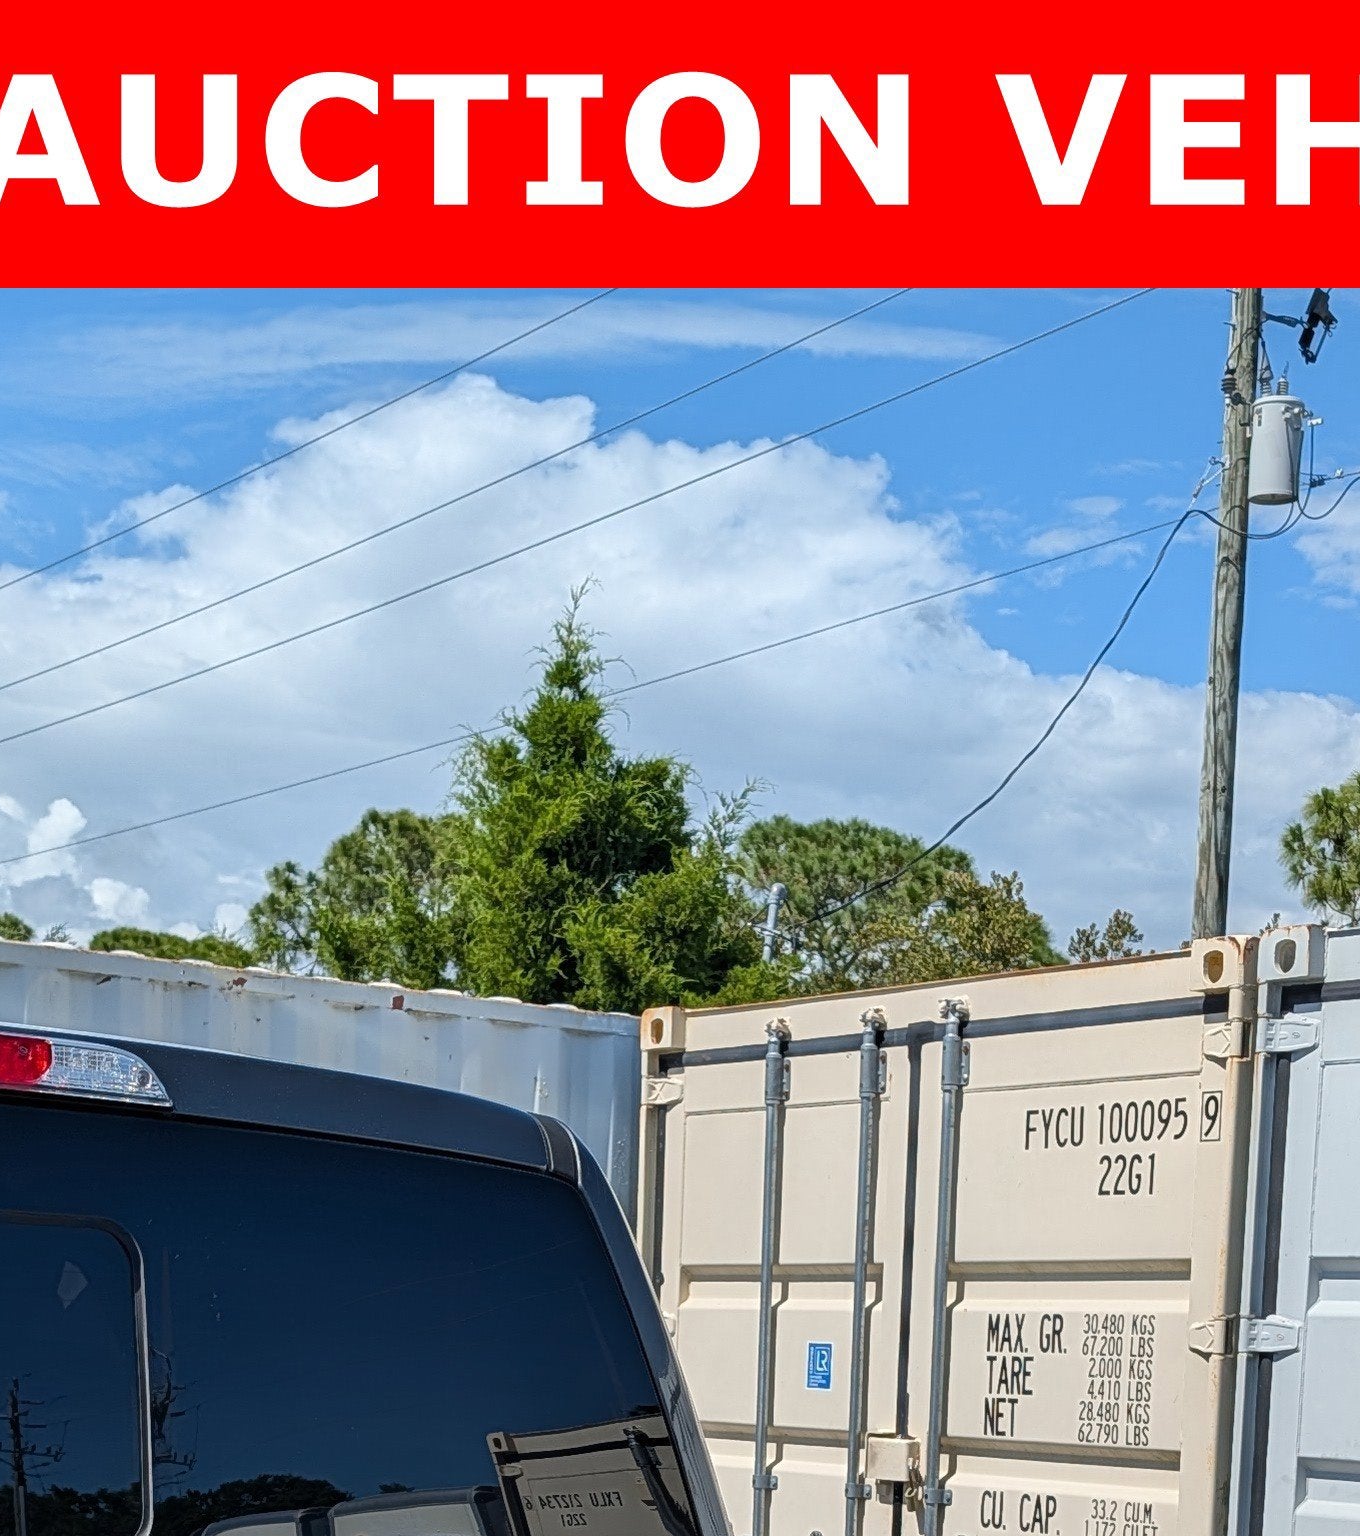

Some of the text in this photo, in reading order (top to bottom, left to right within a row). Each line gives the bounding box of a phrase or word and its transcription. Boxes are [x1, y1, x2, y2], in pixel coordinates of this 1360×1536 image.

[1025, 1095, 1219, 1150] FYCU 100095 9
[1098, 1153, 1156, 1196] 22G1
[986, 1313, 1067, 1354] MAX. GR.
[1131, 1314, 1156, 1336] KGS
[1130, 1336, 1155, 1358] LBS
[986, 1356, 1034, 1396] TARE
[1128, 1358, 1153, 1380] KGS
[1127, 1380, 1152, 1402] LBS
[983, 1397, 1019, 1438] NET
[1126, 1402, 1151, 1424] KGS
[1125, 1424, 1150, 1447] LBS
[980, 1490, 1060, 1536] CU. CAP.
[1091, 1498, 1118, 1521] 33.2
